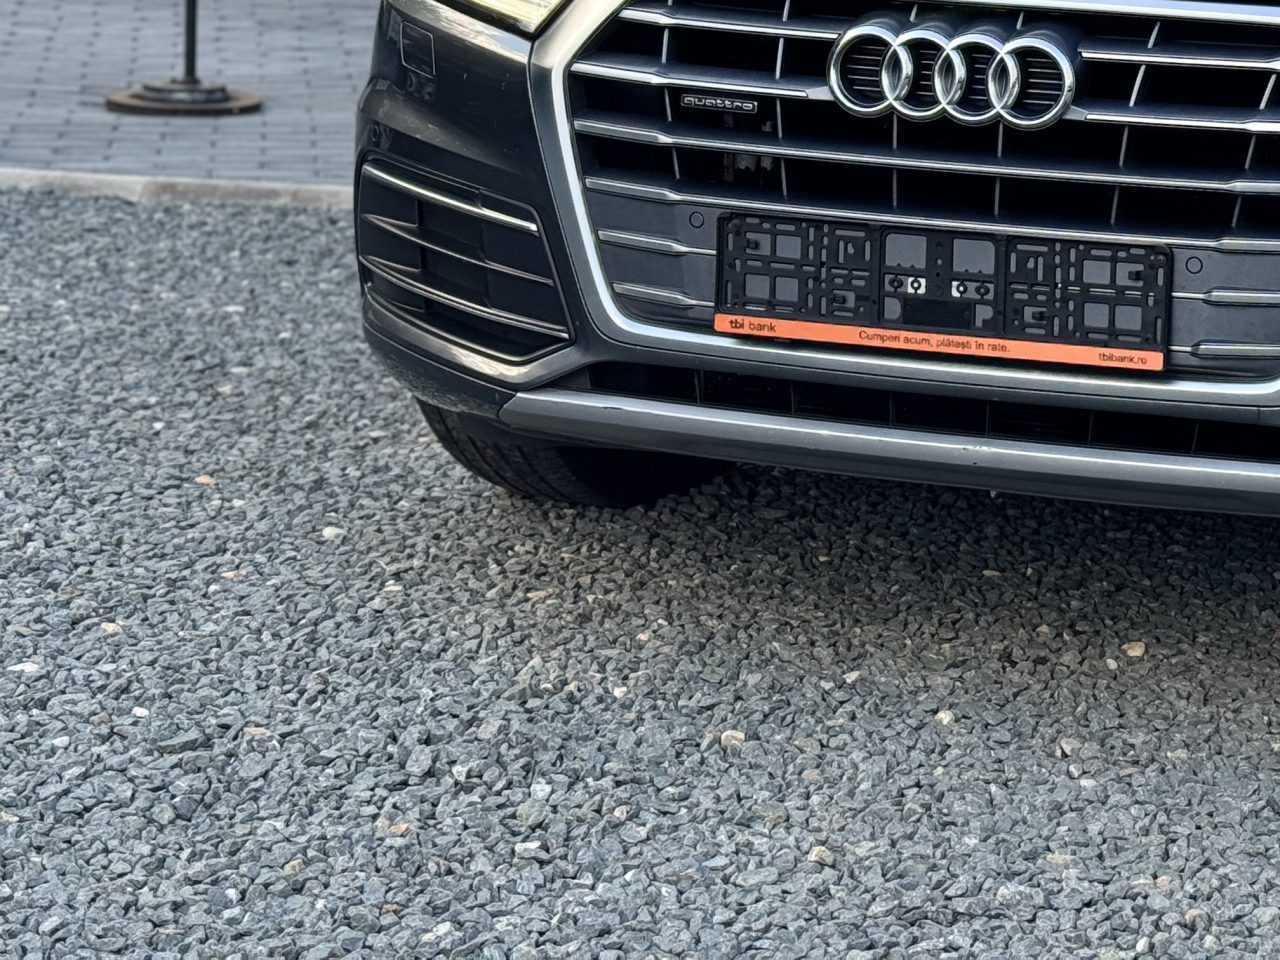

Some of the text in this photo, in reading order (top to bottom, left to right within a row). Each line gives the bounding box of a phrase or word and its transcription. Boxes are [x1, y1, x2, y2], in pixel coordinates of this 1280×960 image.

[684, 97, 753, 110] quattro
[729, 319, 777, 333] tbi bank
[1098, 352, 1148, 366] tbibank.ro
